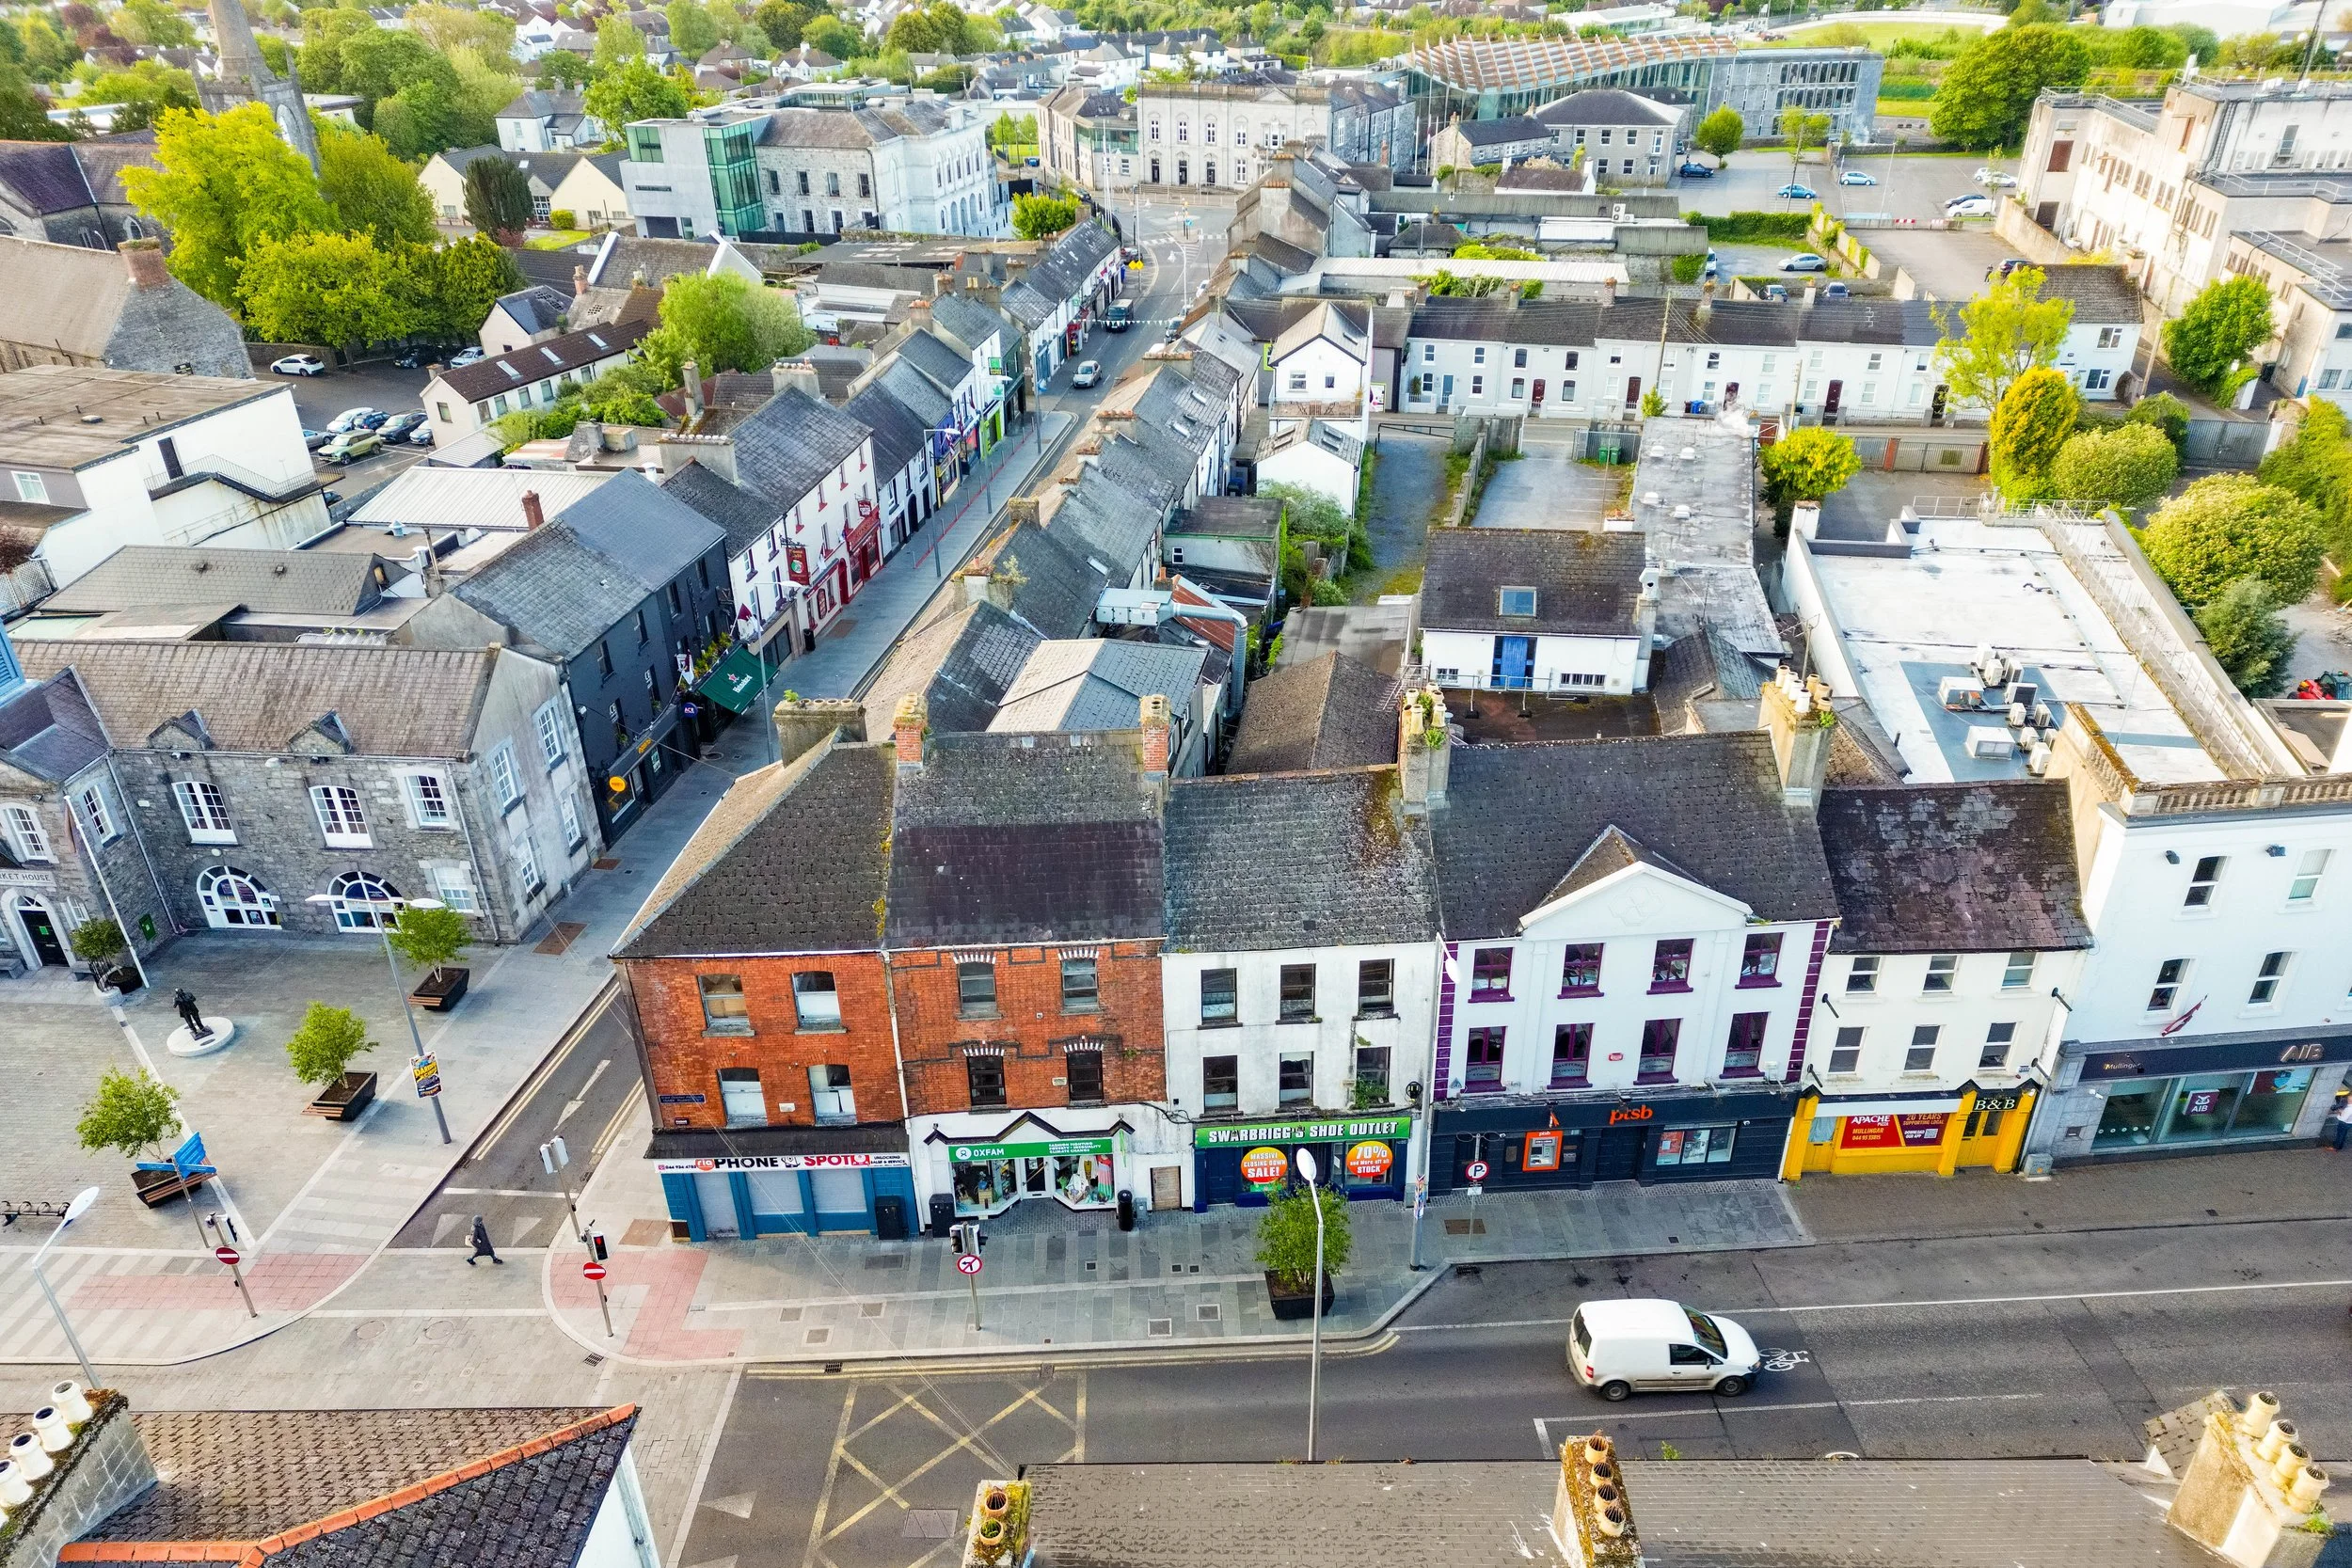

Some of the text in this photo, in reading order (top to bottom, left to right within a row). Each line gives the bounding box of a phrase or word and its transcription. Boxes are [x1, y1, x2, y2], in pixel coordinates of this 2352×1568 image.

[22, 873, 51, 881] HOUSE
[2280, 1043, 2325, 1063] AIB
[2191, 1104, 2209, 1113] AIB
[1609, 1104, 1654, 1126] ptsb
[1851, 1115, 1891, 1125] APACHE
[1209, 1122, 1397, 1143] SWARBRIGG'S SHOE OUTLET
[973, 1148, 1005, 1157] OXFAM
[1357, 1146, 1388, 1160] 70%
[714, 1156, 780, 1168] PHONE
[1248, 1166, 1280, 1179] SALE!
[1358, 1165, 1381, 1174] STOCK
